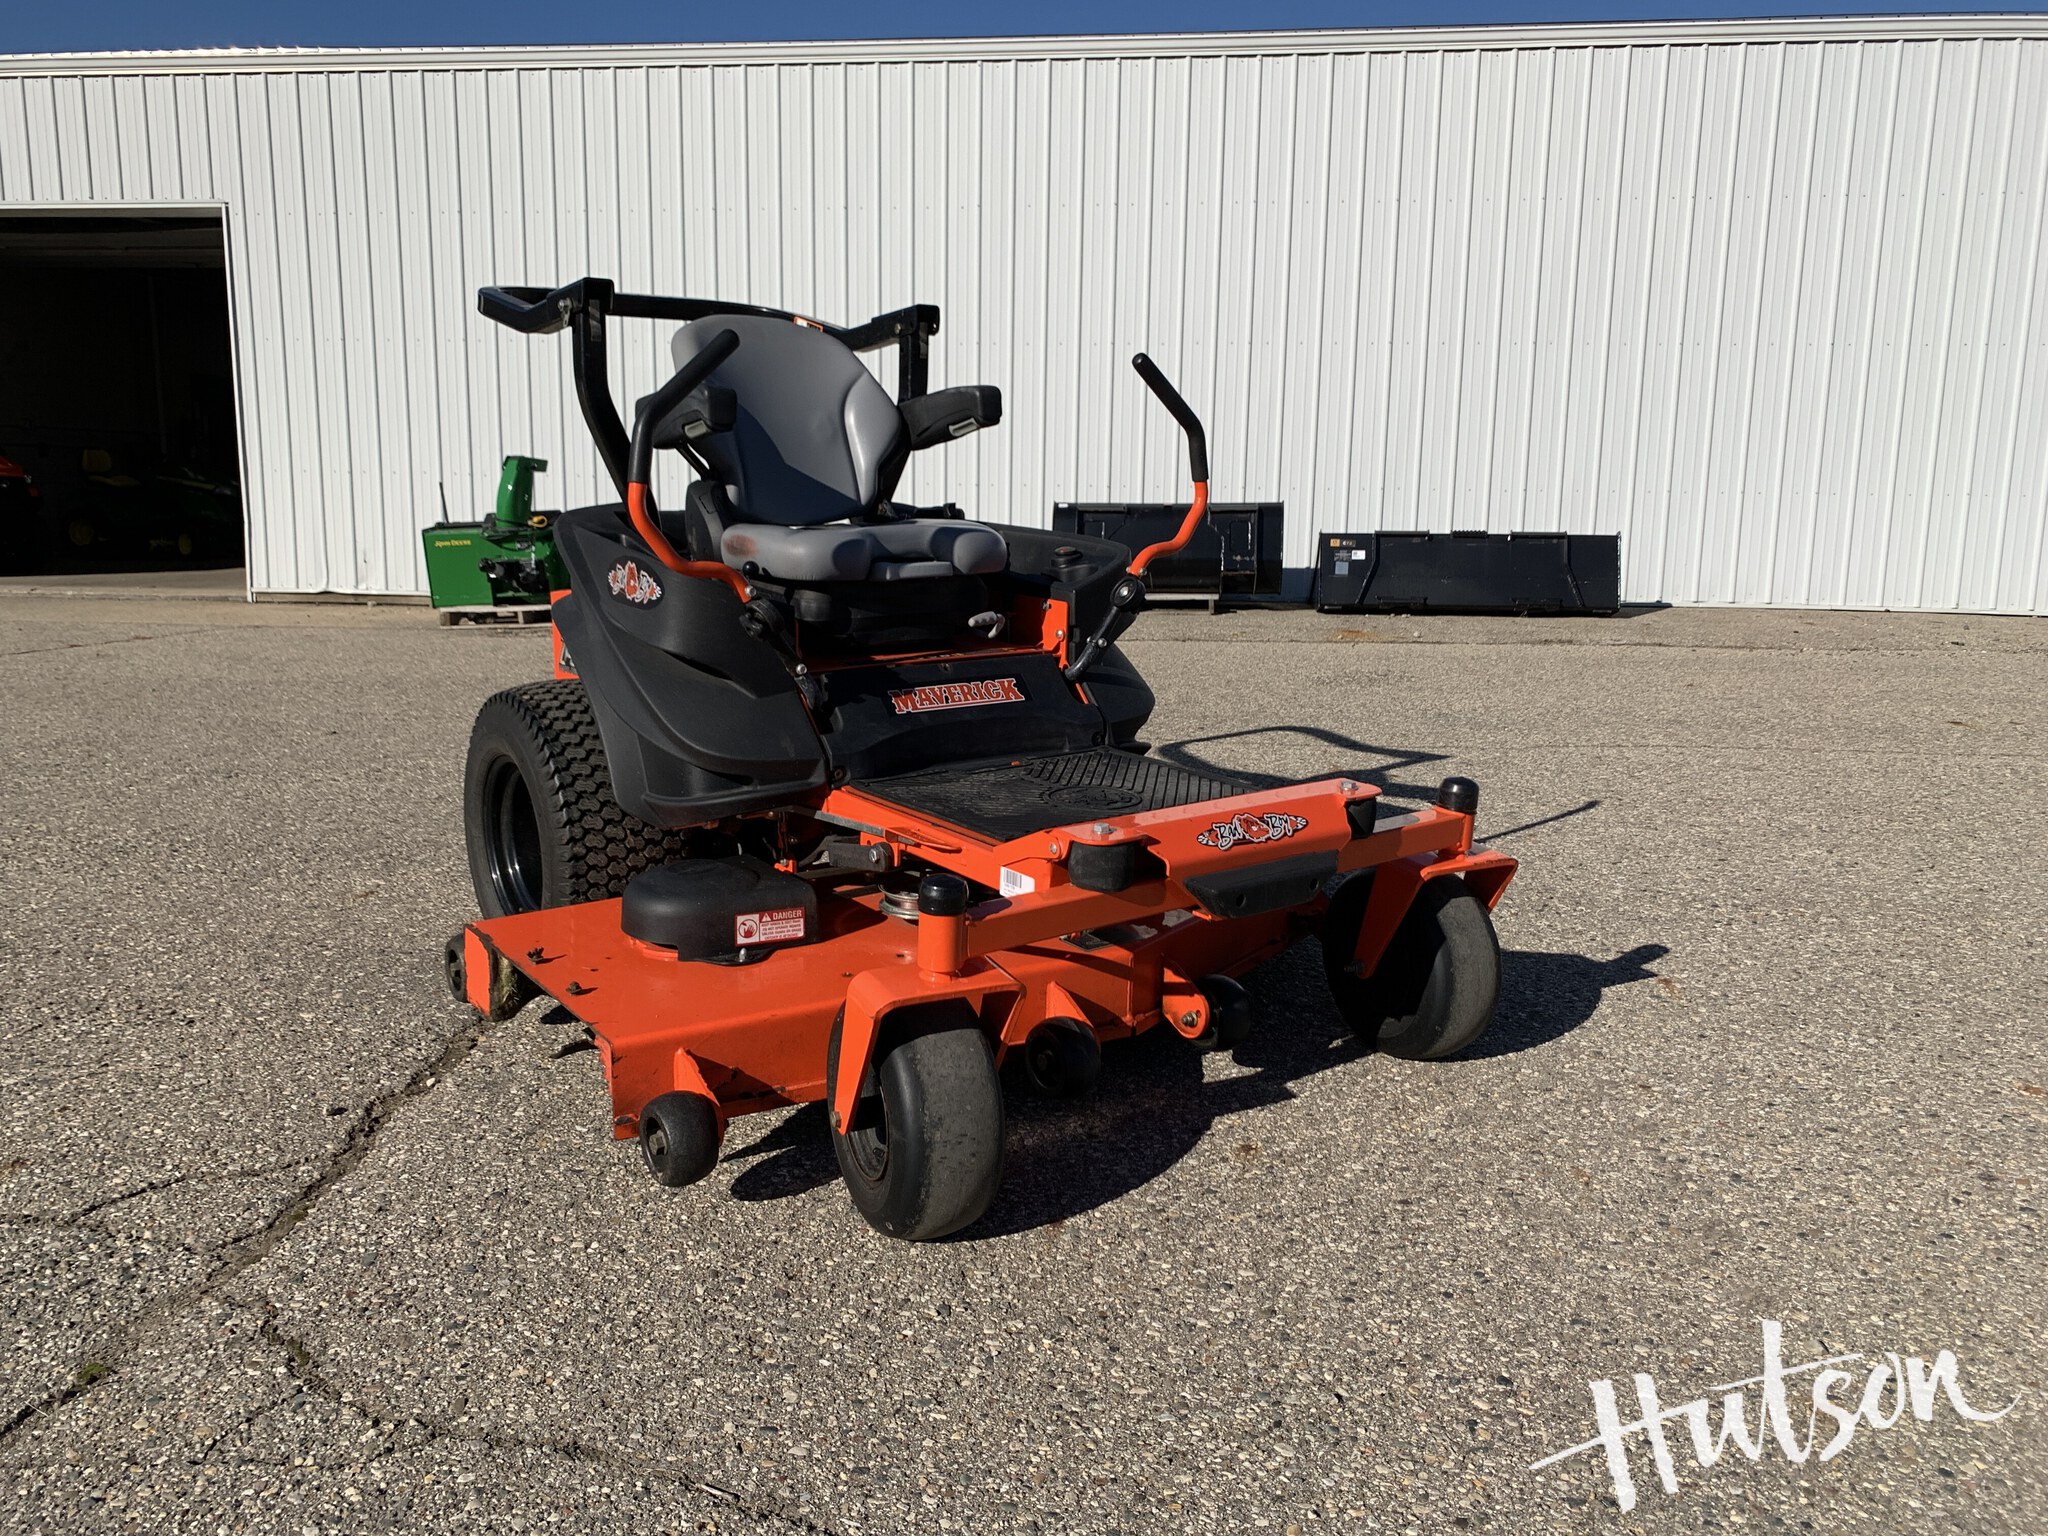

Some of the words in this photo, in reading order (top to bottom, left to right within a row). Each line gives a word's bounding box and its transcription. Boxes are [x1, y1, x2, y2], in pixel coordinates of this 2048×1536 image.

[888, 678, 1025, 714] MAVERICK
[1263, 813, 1293, 840] Boy
[772, 910, 802, 920] DANGER
